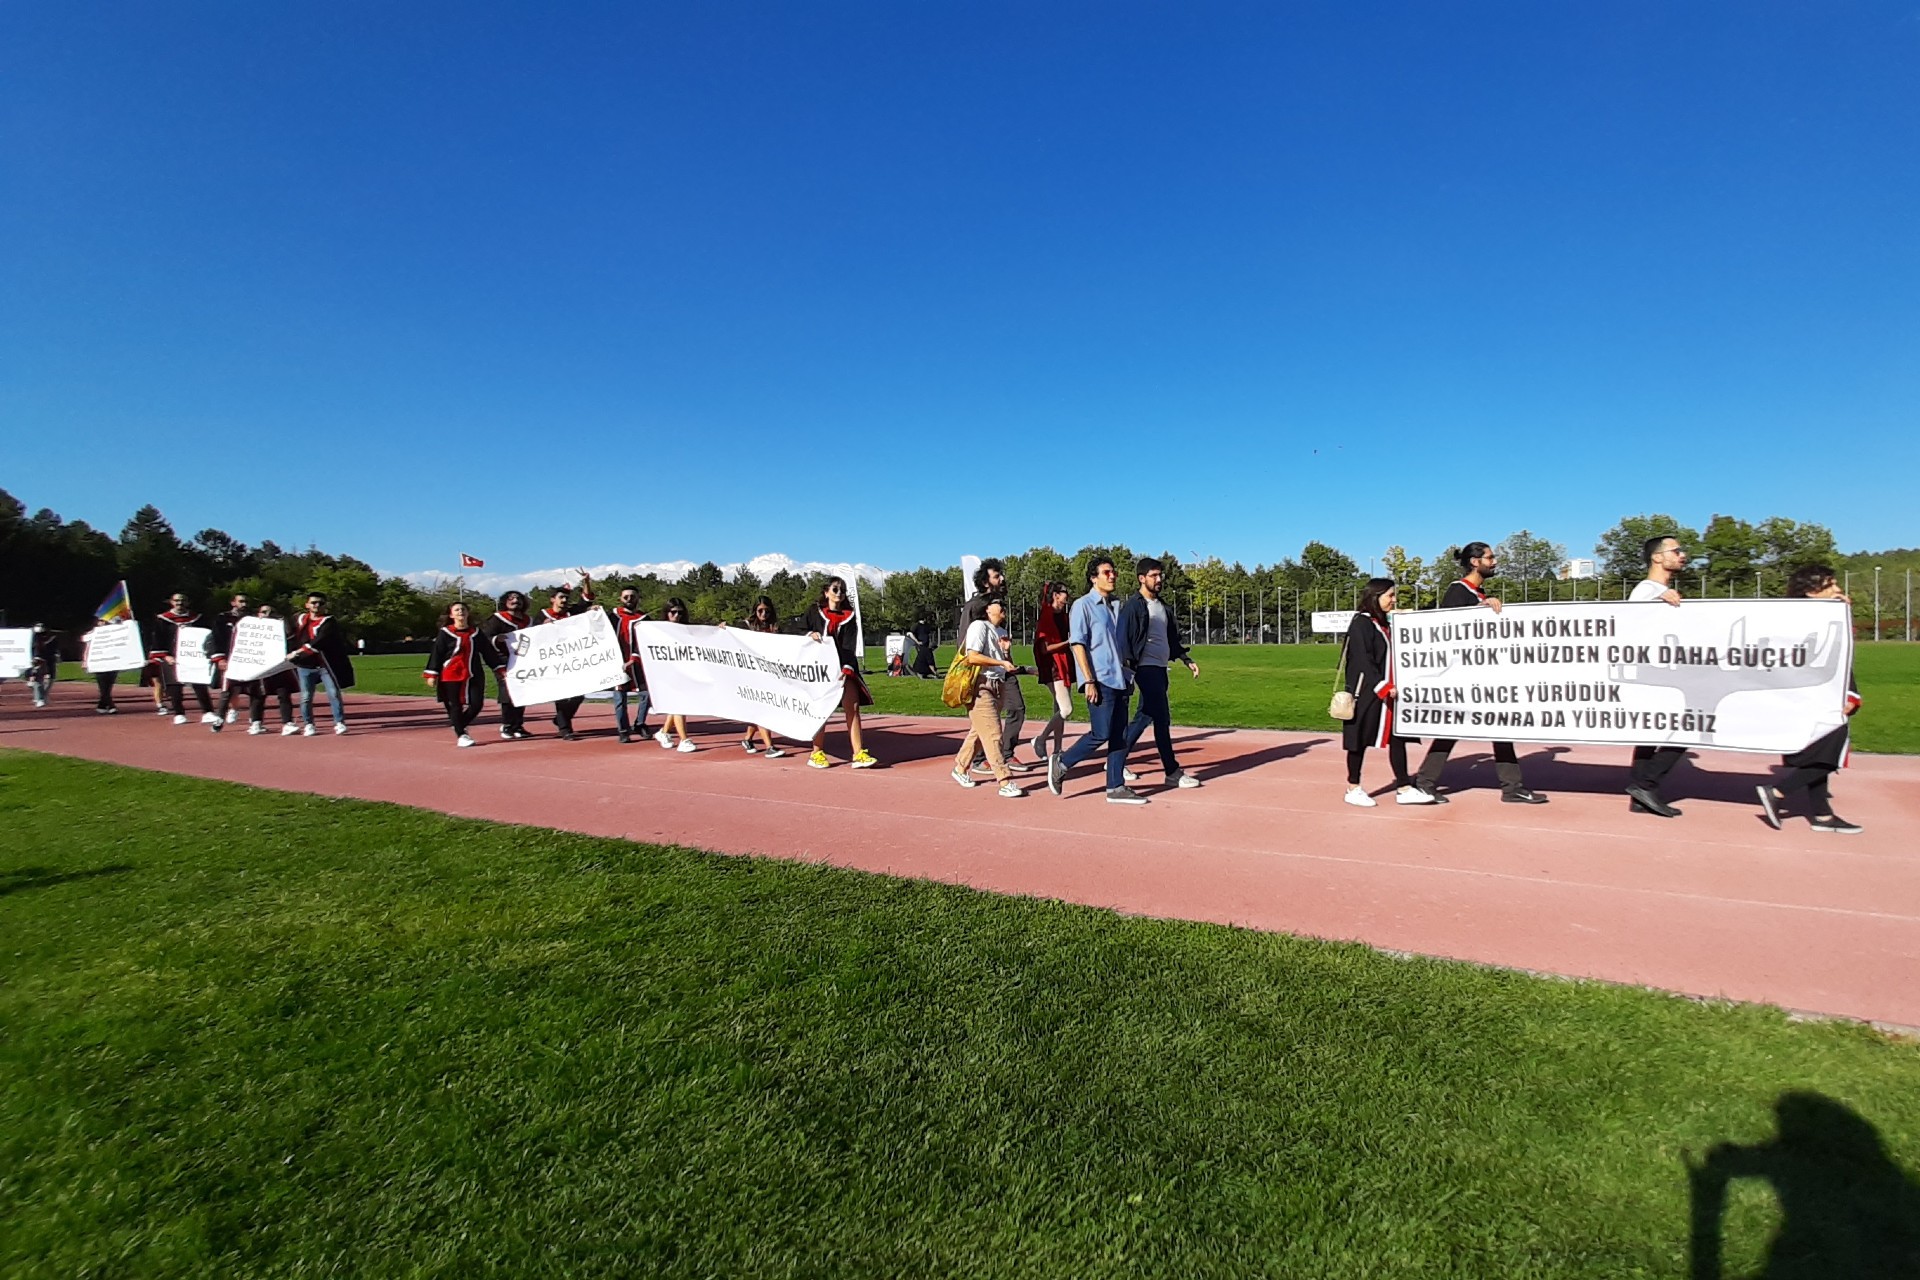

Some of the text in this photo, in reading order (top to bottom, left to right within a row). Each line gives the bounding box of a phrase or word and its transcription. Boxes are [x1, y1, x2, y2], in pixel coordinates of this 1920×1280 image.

[1400, 615, 1616, 644] BU KÜLTÜRÜN KÖKLERİ
[539, 635, 599, 660] BAŞIMIZA
[647, 641, 694, 661] TESLİME
[696, 646, 736, 668] PANKARTI
[735, 649, 756, 670] BİLE
[1400, 647, 1448, 668] SİZİN
[1607, 645, 1651, 668] ÇOK
[1658, 645, 1719, 666] DAHA
[1727, 643, 1807, 672] GÜÇLÜ
[515, 648, 616, 683] ÇAY YAĞACAK!
[1402, 681, 1622, 704] SİZDEN ÖNCE YÜRÜDÜK
[1401, 705, 1717, 734] SİZDEN SONRA DA YÜRÜYECEĞİZ
